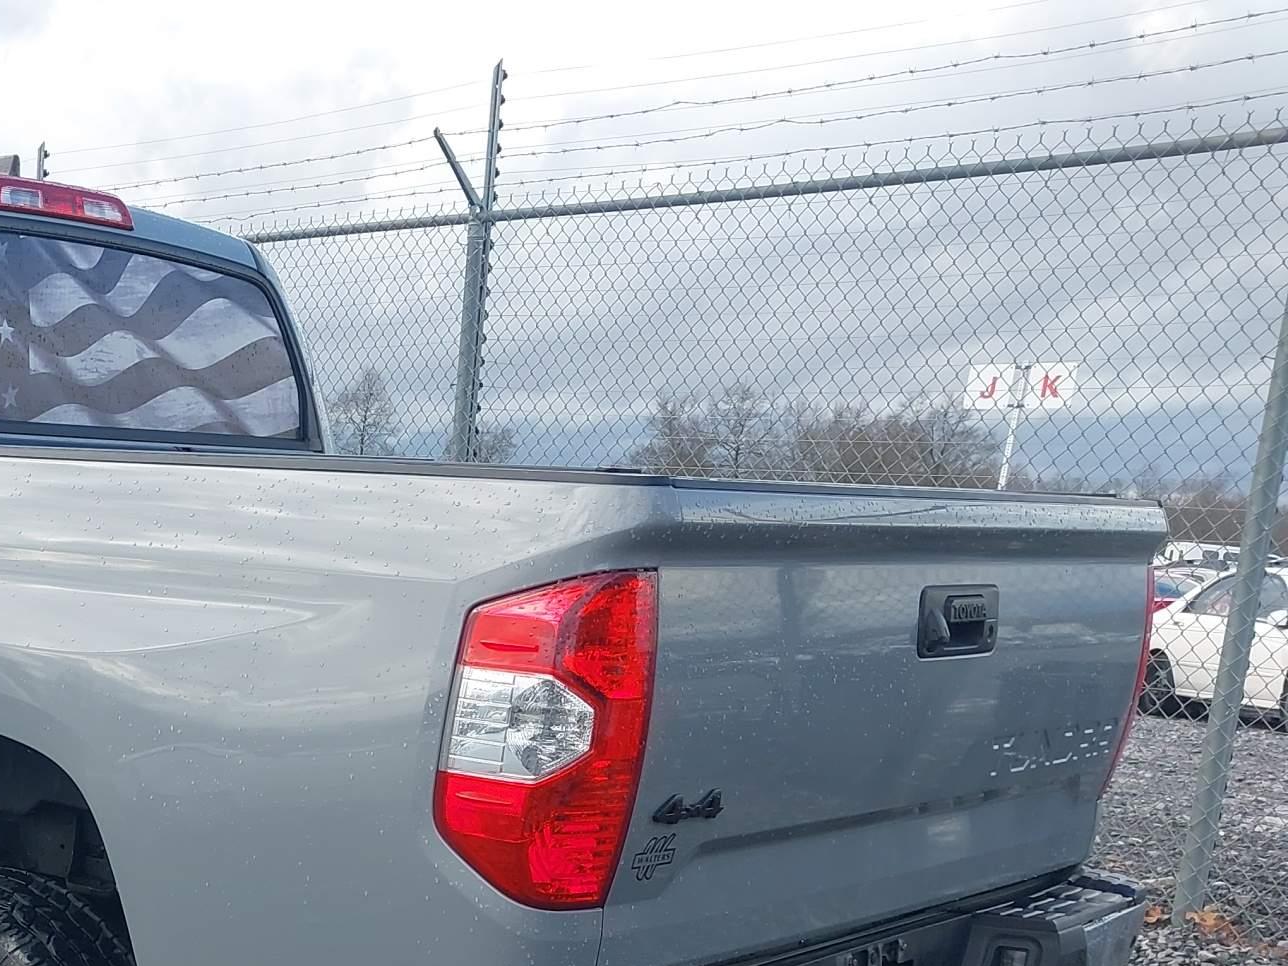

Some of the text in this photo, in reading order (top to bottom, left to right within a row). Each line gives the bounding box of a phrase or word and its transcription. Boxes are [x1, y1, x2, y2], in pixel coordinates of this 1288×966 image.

[979, 376, 999, 399] J
[1040, 373, 1062, 398] K
[952, 603, 987, 619] TOYOTA
